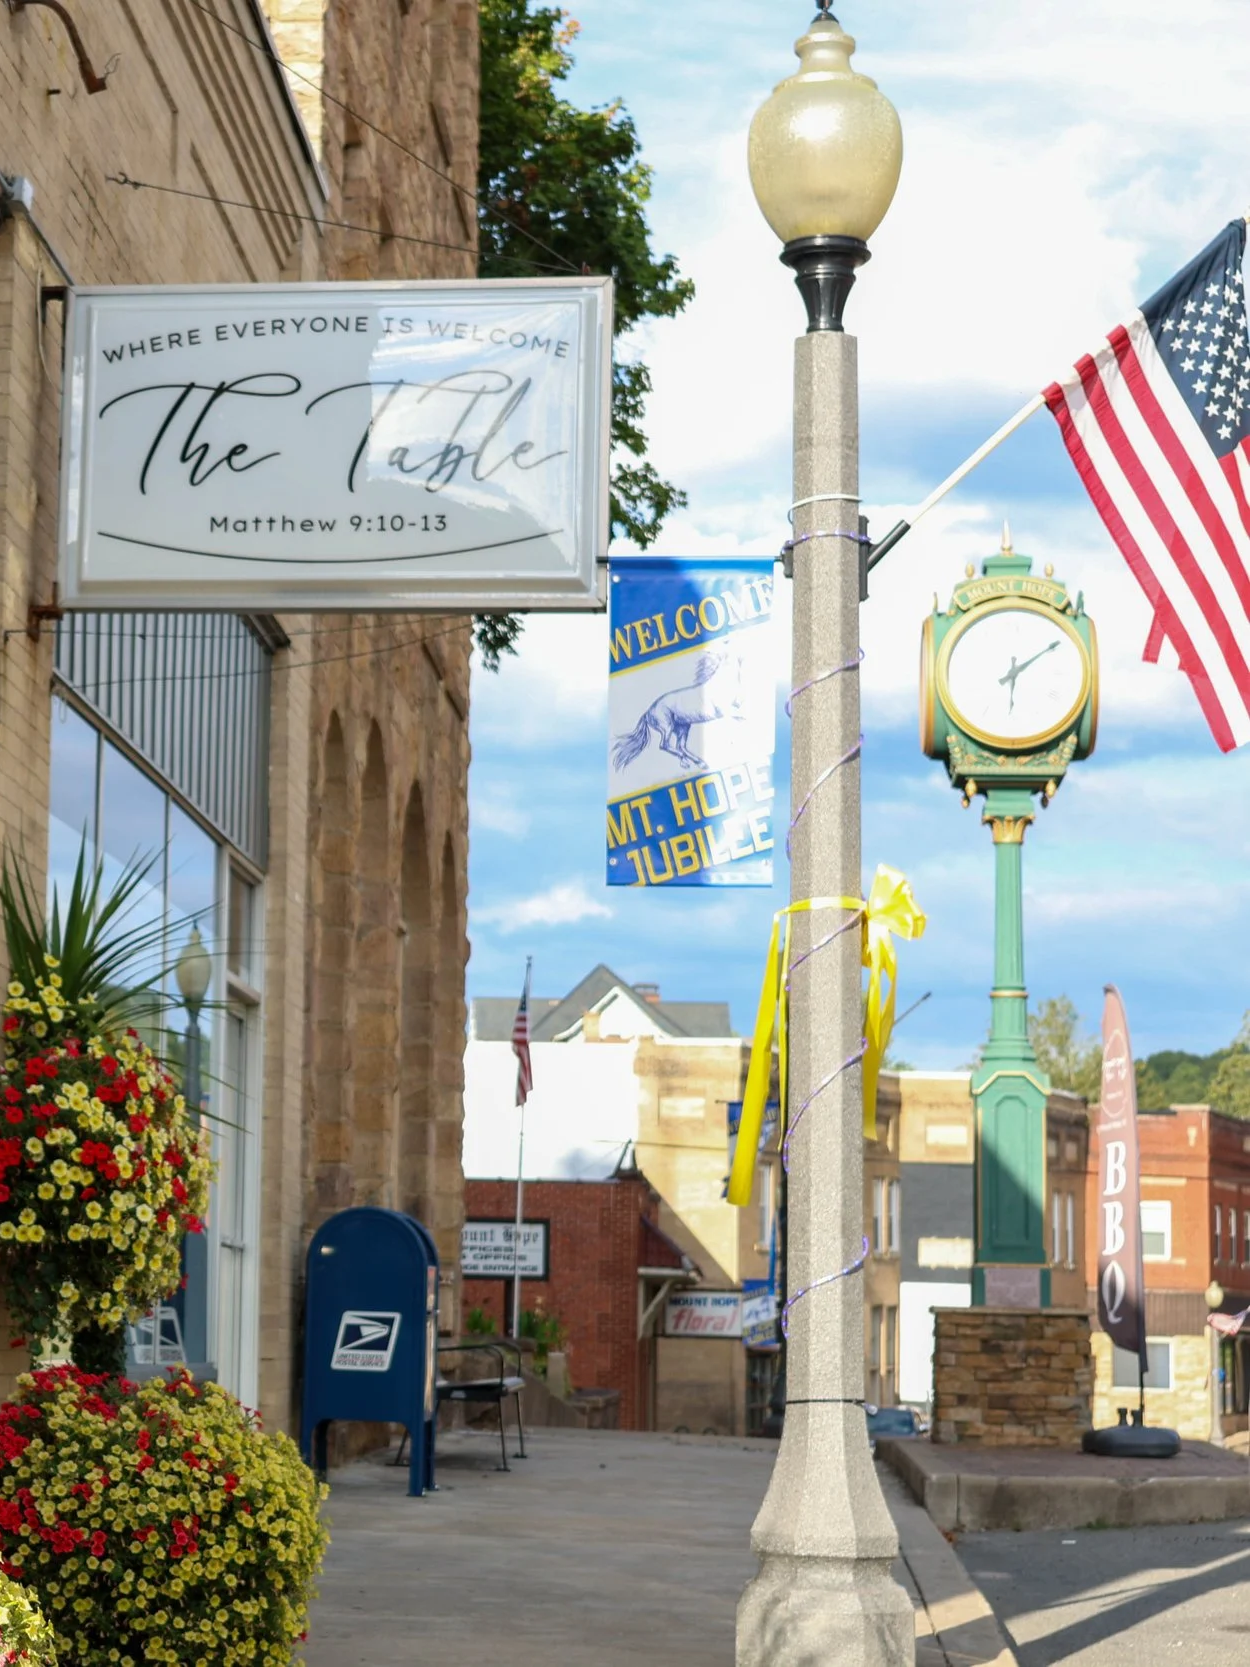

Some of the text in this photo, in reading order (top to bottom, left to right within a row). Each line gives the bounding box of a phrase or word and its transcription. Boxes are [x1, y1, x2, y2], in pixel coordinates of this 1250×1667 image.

[103, 316, 570, 364] WHERE EVERYONE IS WELCOME
[99, 370, 568, 495] The Table
[210, 514, 448, 534] Matthew 9:10-13
[609, 574, 775, 664] WELCOME
[607, 754, 774, 849] MT. HOPE
[626, 806, 774, 887] JUBILEE
[1103, 1140, 1126, 1325] BBQ
[672, 1308, 738, 1331] floral
